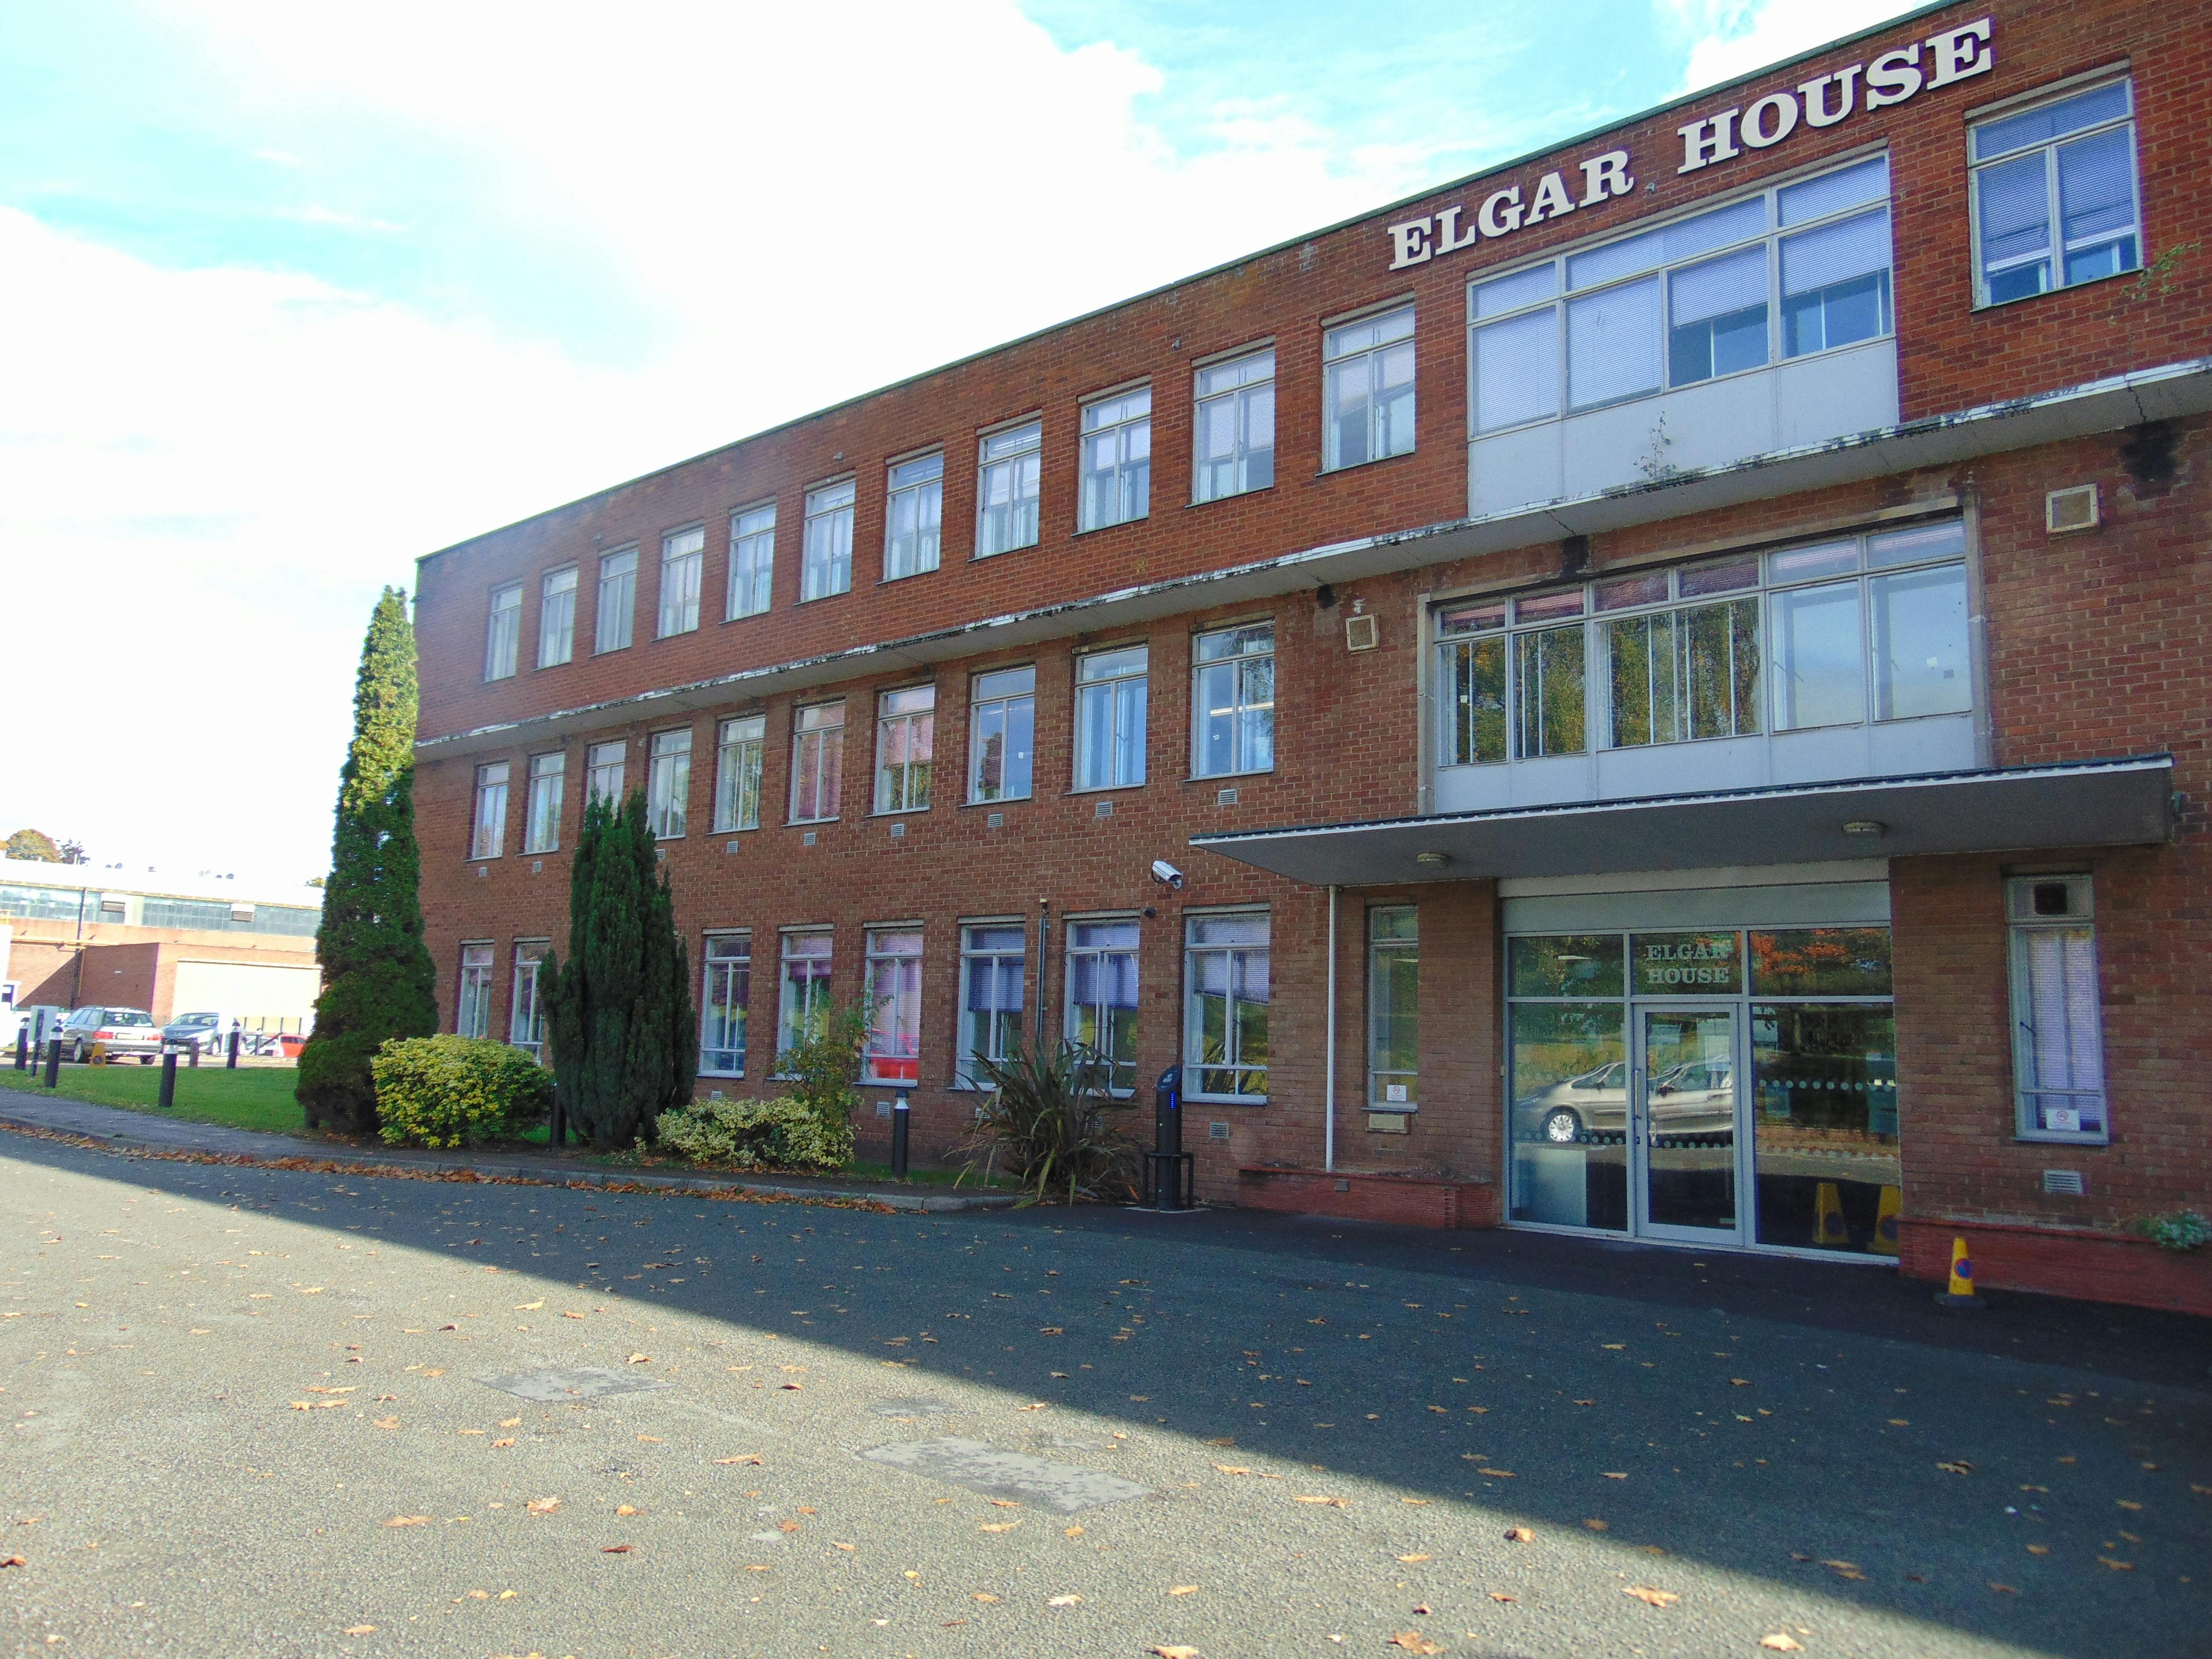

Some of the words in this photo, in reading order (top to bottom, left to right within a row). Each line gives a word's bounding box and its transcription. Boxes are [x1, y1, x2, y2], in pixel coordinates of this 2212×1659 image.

[1387, 150, 1634, 270] ELGAR
[1677, 18, 1992, 174] HOUSE
[1647, 967, 1729, 984] HOUSE
